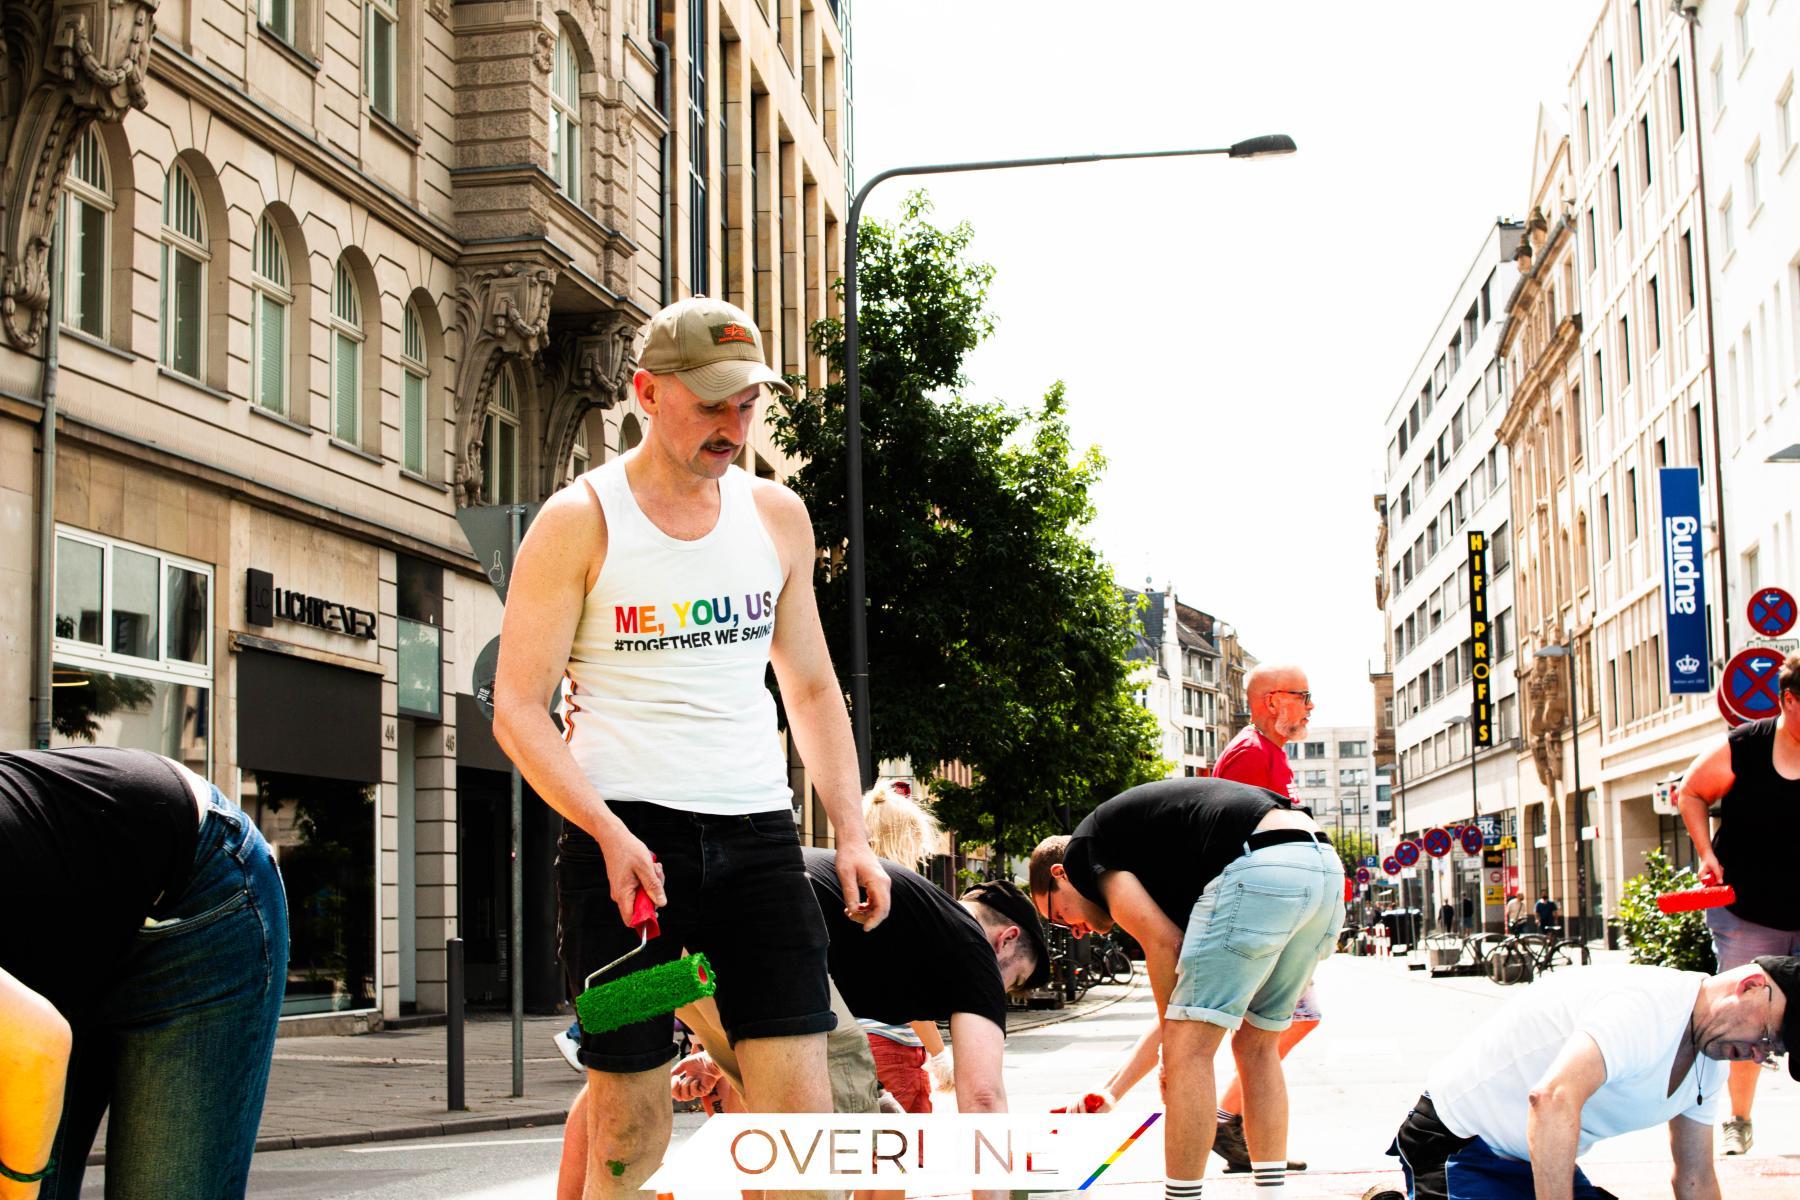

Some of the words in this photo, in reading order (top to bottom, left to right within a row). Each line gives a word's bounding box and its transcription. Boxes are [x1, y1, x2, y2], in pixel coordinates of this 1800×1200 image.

[1470, 534, 1482, 612] HIFI
[1671, 516, 1700, 615] auping
[615, 605, 665, 637] ME,
[672, 596, 739, 628] YOU,
[614, 631, 713, 652] #TOGETHER
[715, 628, 739, 645] WE
[1473, 622, 1490, 741] PROFIS
[385, 724, 395, 742] 44
[445, 734, 455, 752] 46
